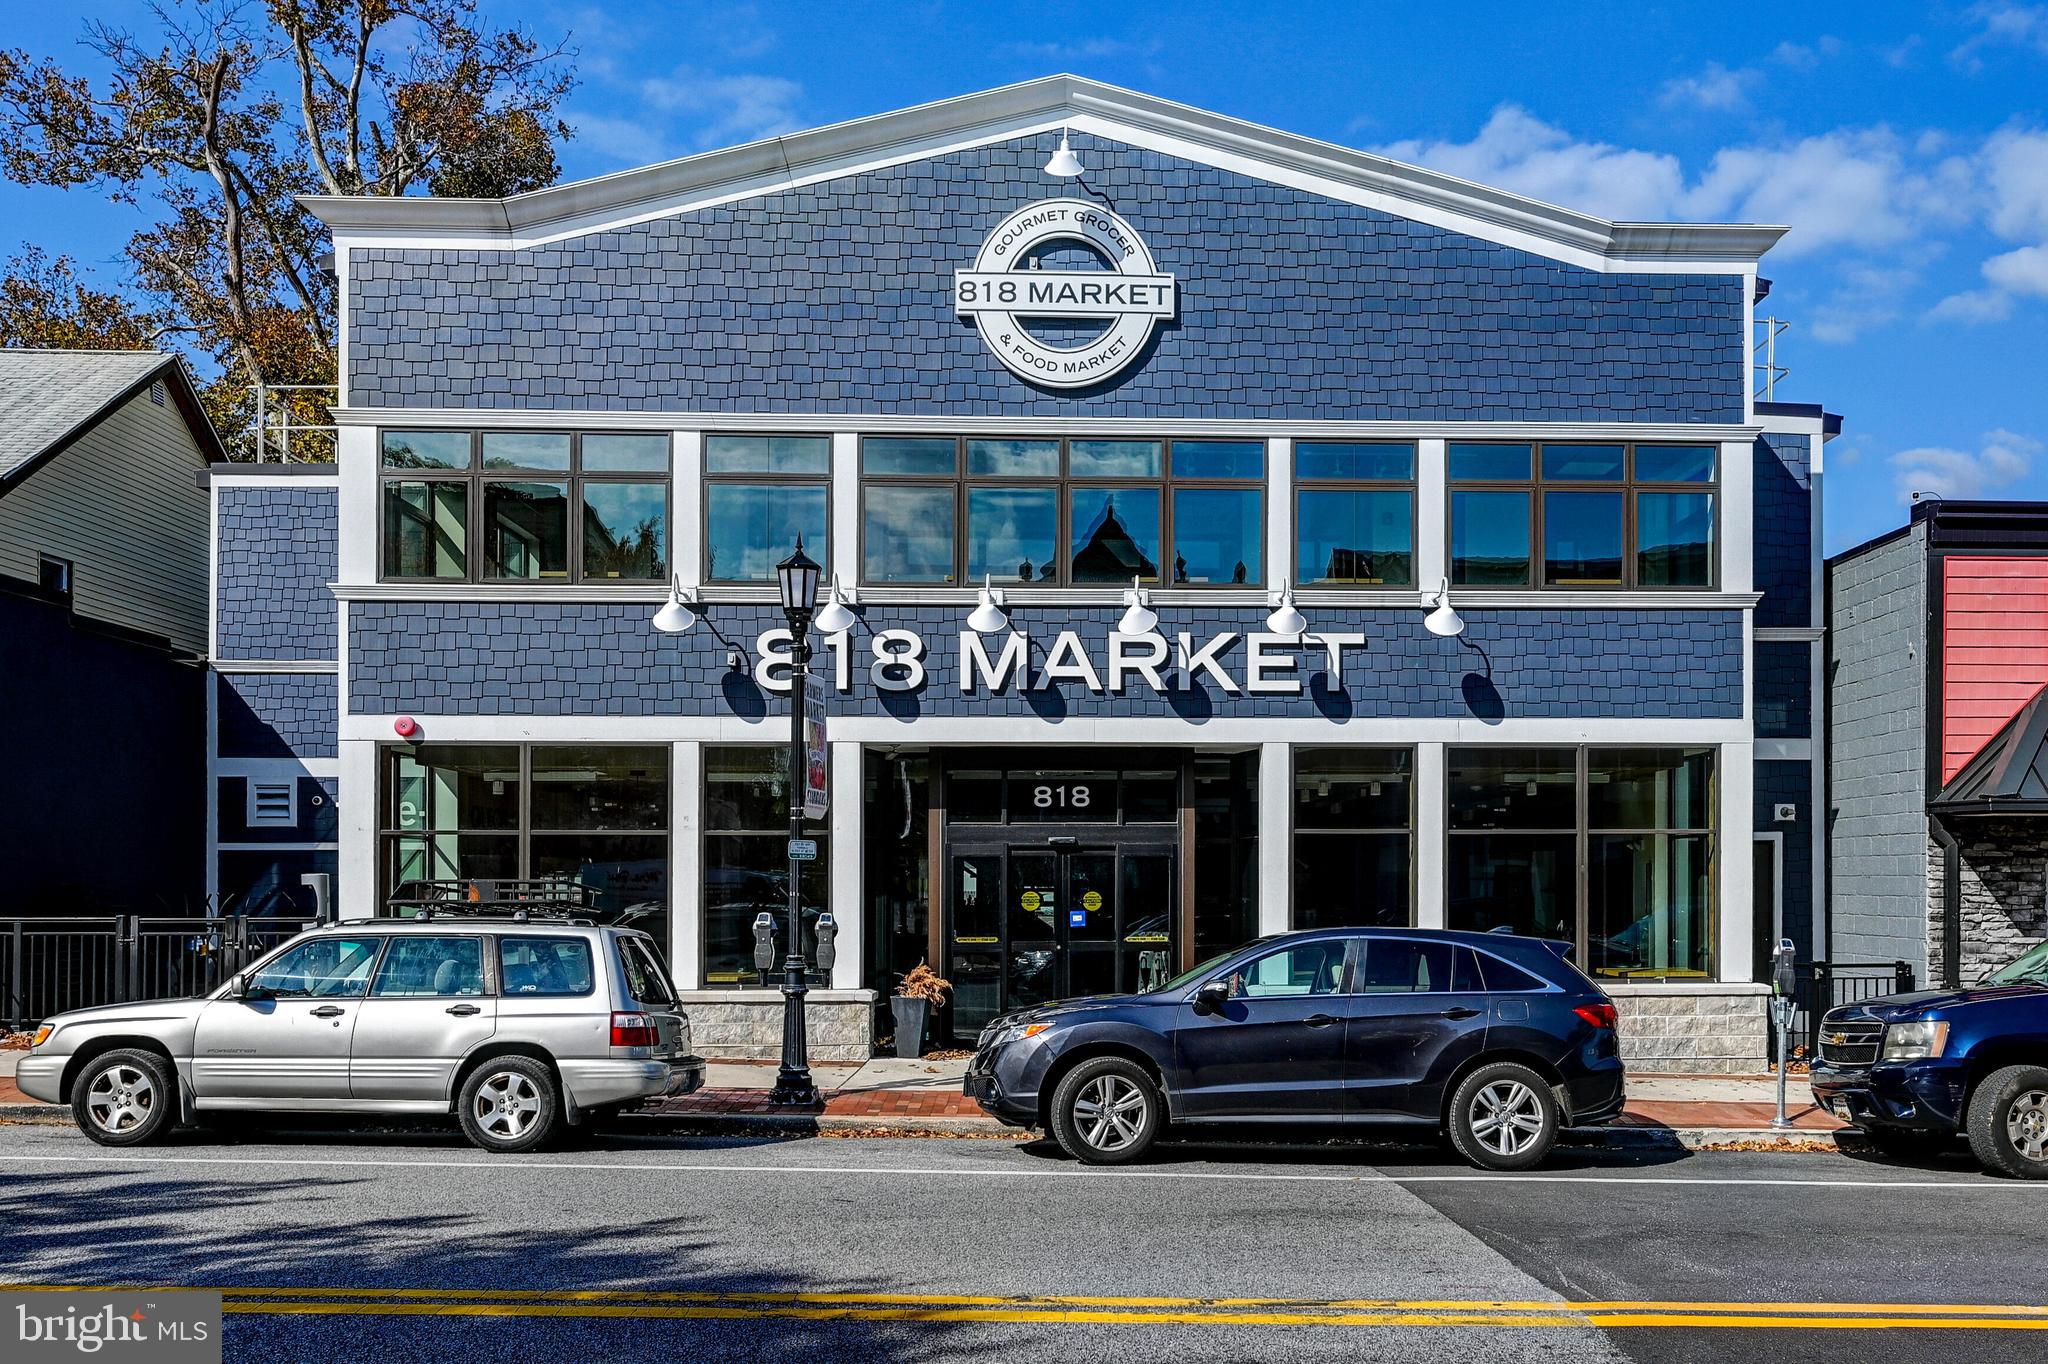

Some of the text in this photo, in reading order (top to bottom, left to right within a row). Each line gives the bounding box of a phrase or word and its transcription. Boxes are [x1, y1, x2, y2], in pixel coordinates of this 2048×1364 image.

[994, 209, 1135, 257] GOURMET GROCER
[958, 281, 1171, 305] 818 MARKET
[1000, 333, 1126, 373] & FOOD MARKET
[755, 628, 1365, 692] 818 MARKET
[1033, 786, 1090, 807] 818
